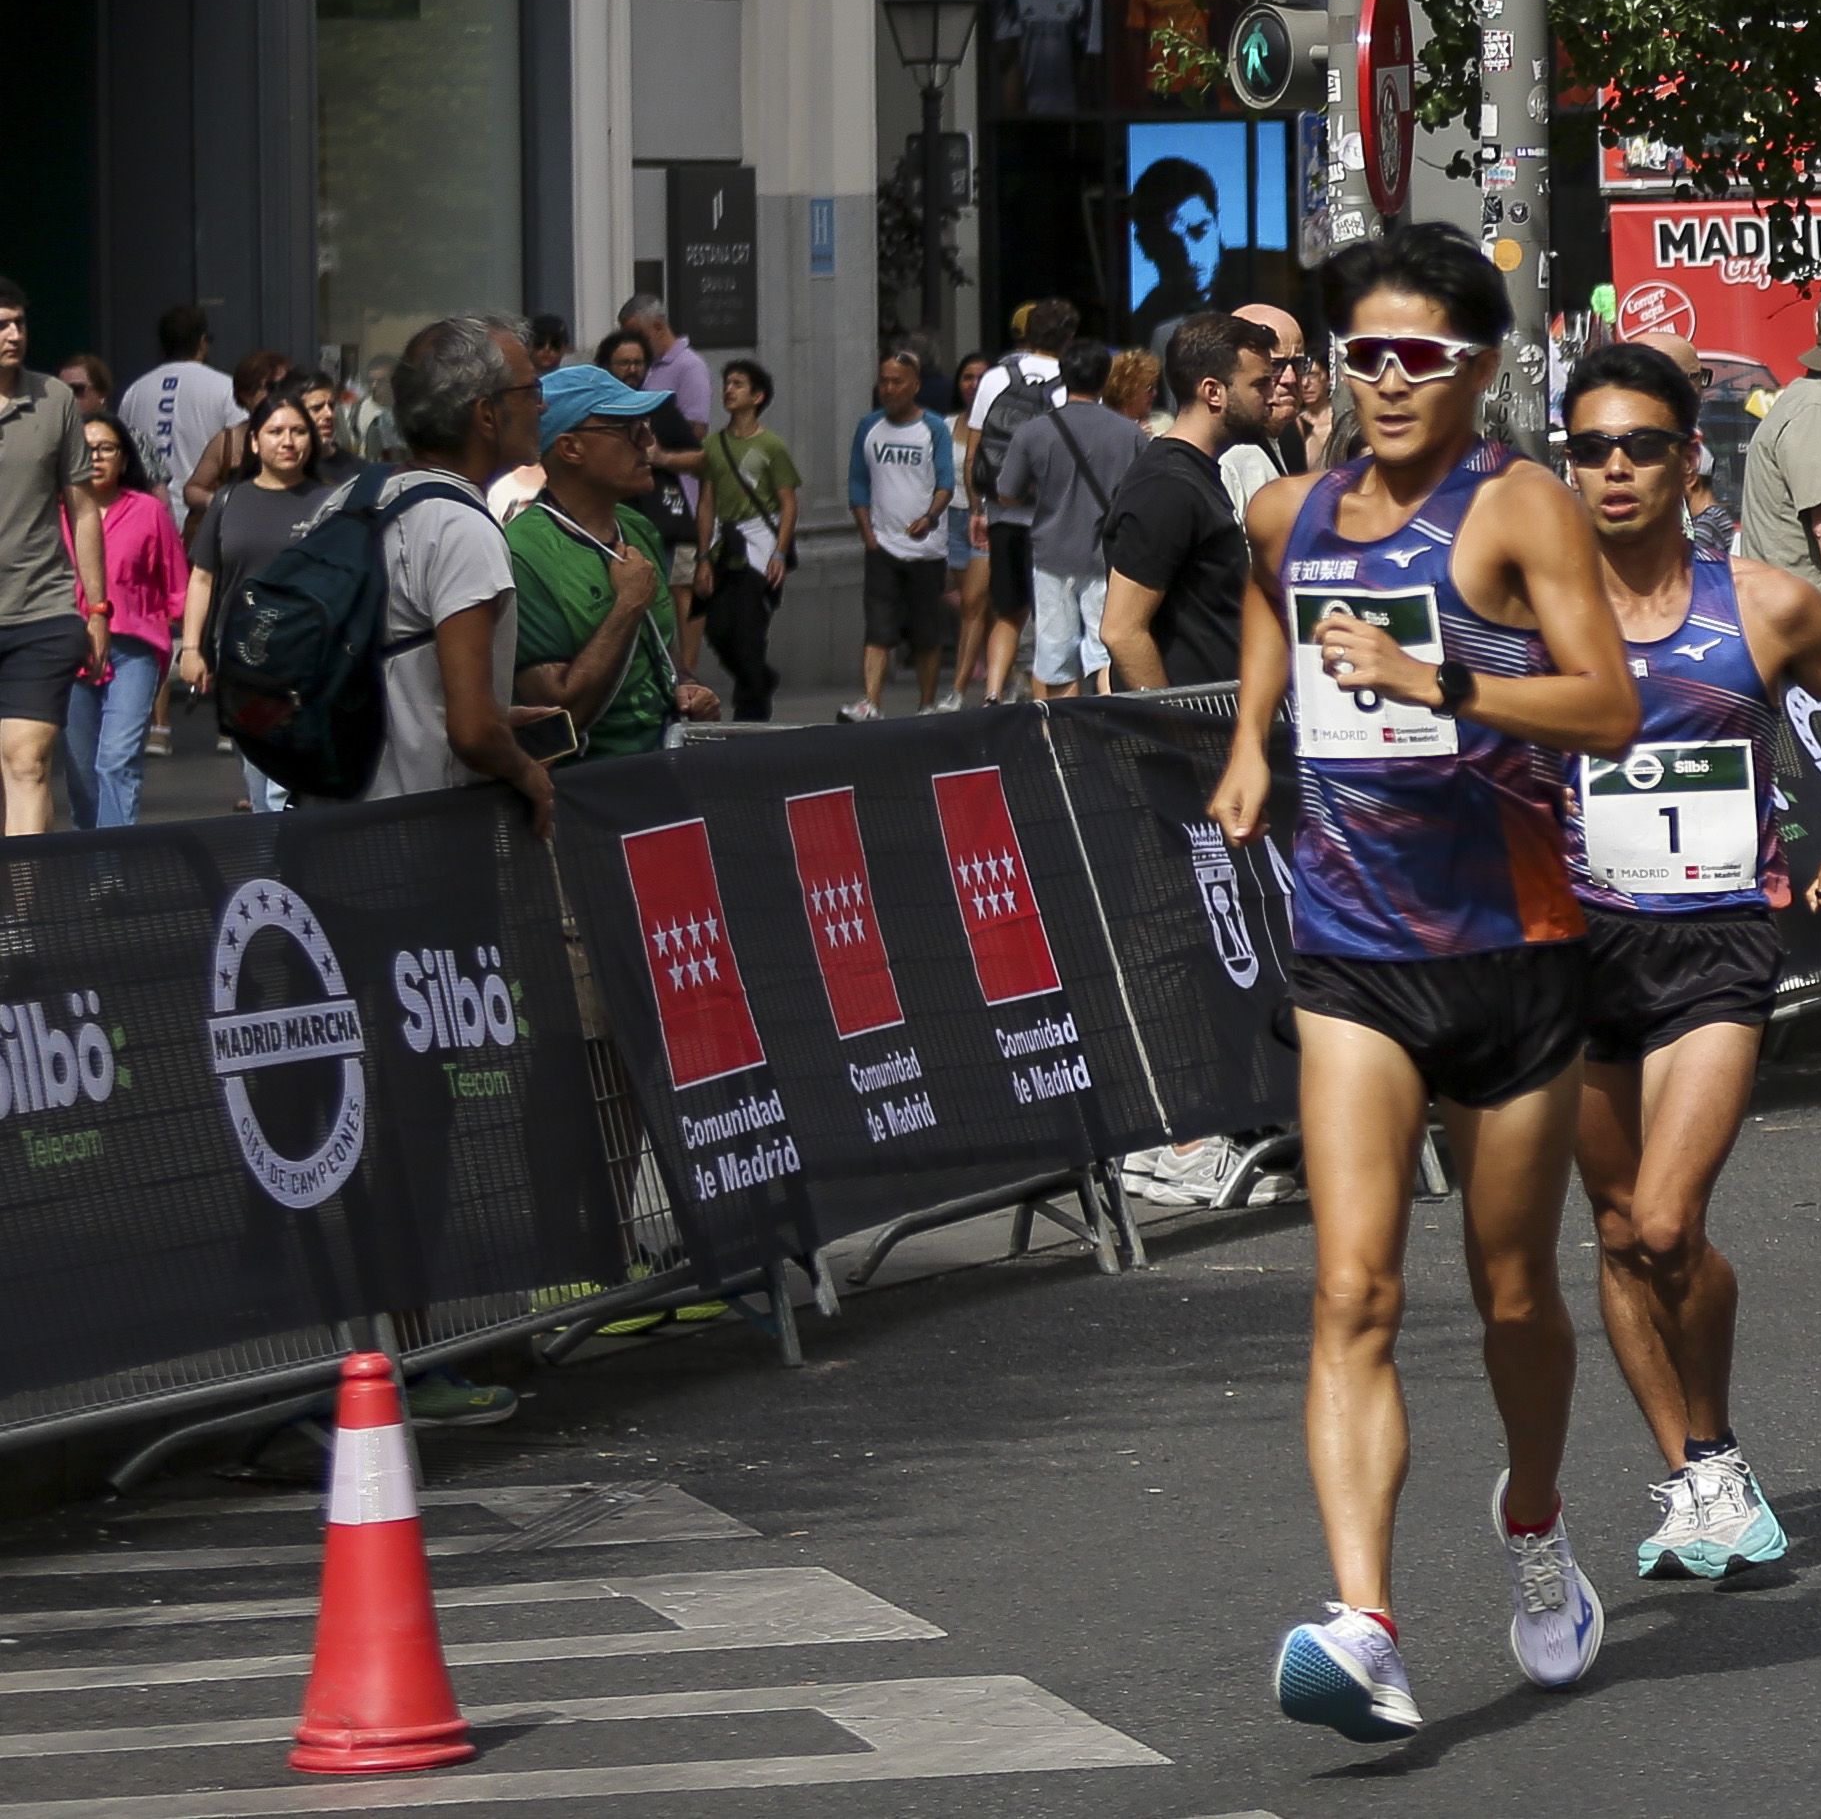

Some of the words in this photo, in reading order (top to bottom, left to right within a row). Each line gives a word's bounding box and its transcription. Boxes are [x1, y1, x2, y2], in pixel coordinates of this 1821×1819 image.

[156, 376, 180, 459] BURT
[873, 441, 923, 467] VANS
[1321, 729, 1368, 741] MADRID
[1673, 758, 1710, 775] Silbö
[1658, 806, 1682, 854] 1
[1620, 867, 1670, 880] MADRID
[395, 945, 516, 1053] Silbö
[0, 990, 115, 1121] ilbö
[214, 1021, 283, 1061] MADRID
[285, 1010, 362, 1050] MARCHA
[996, 1012, 1078, 1059] Comunidad
[849, 1047, 922, 1094] Comunidad
[1012, 1071, 1031, 1104] de
[1034, 1054, 1092, 1102] Madrid
[682, 1089, 786, 1150] Comunidad
[866, 1107, 884, 1144] de
[883, 1091, 937, 1138] Madrid
[241, 1116, 265, 1172] CITA
[270, 1161, 287, 1192] DE
[290, 1098, 360, 1195] CAMPEONES
[695, 1164, 717, 1202] de
[718, 1135, 801, 1195] Madrid
